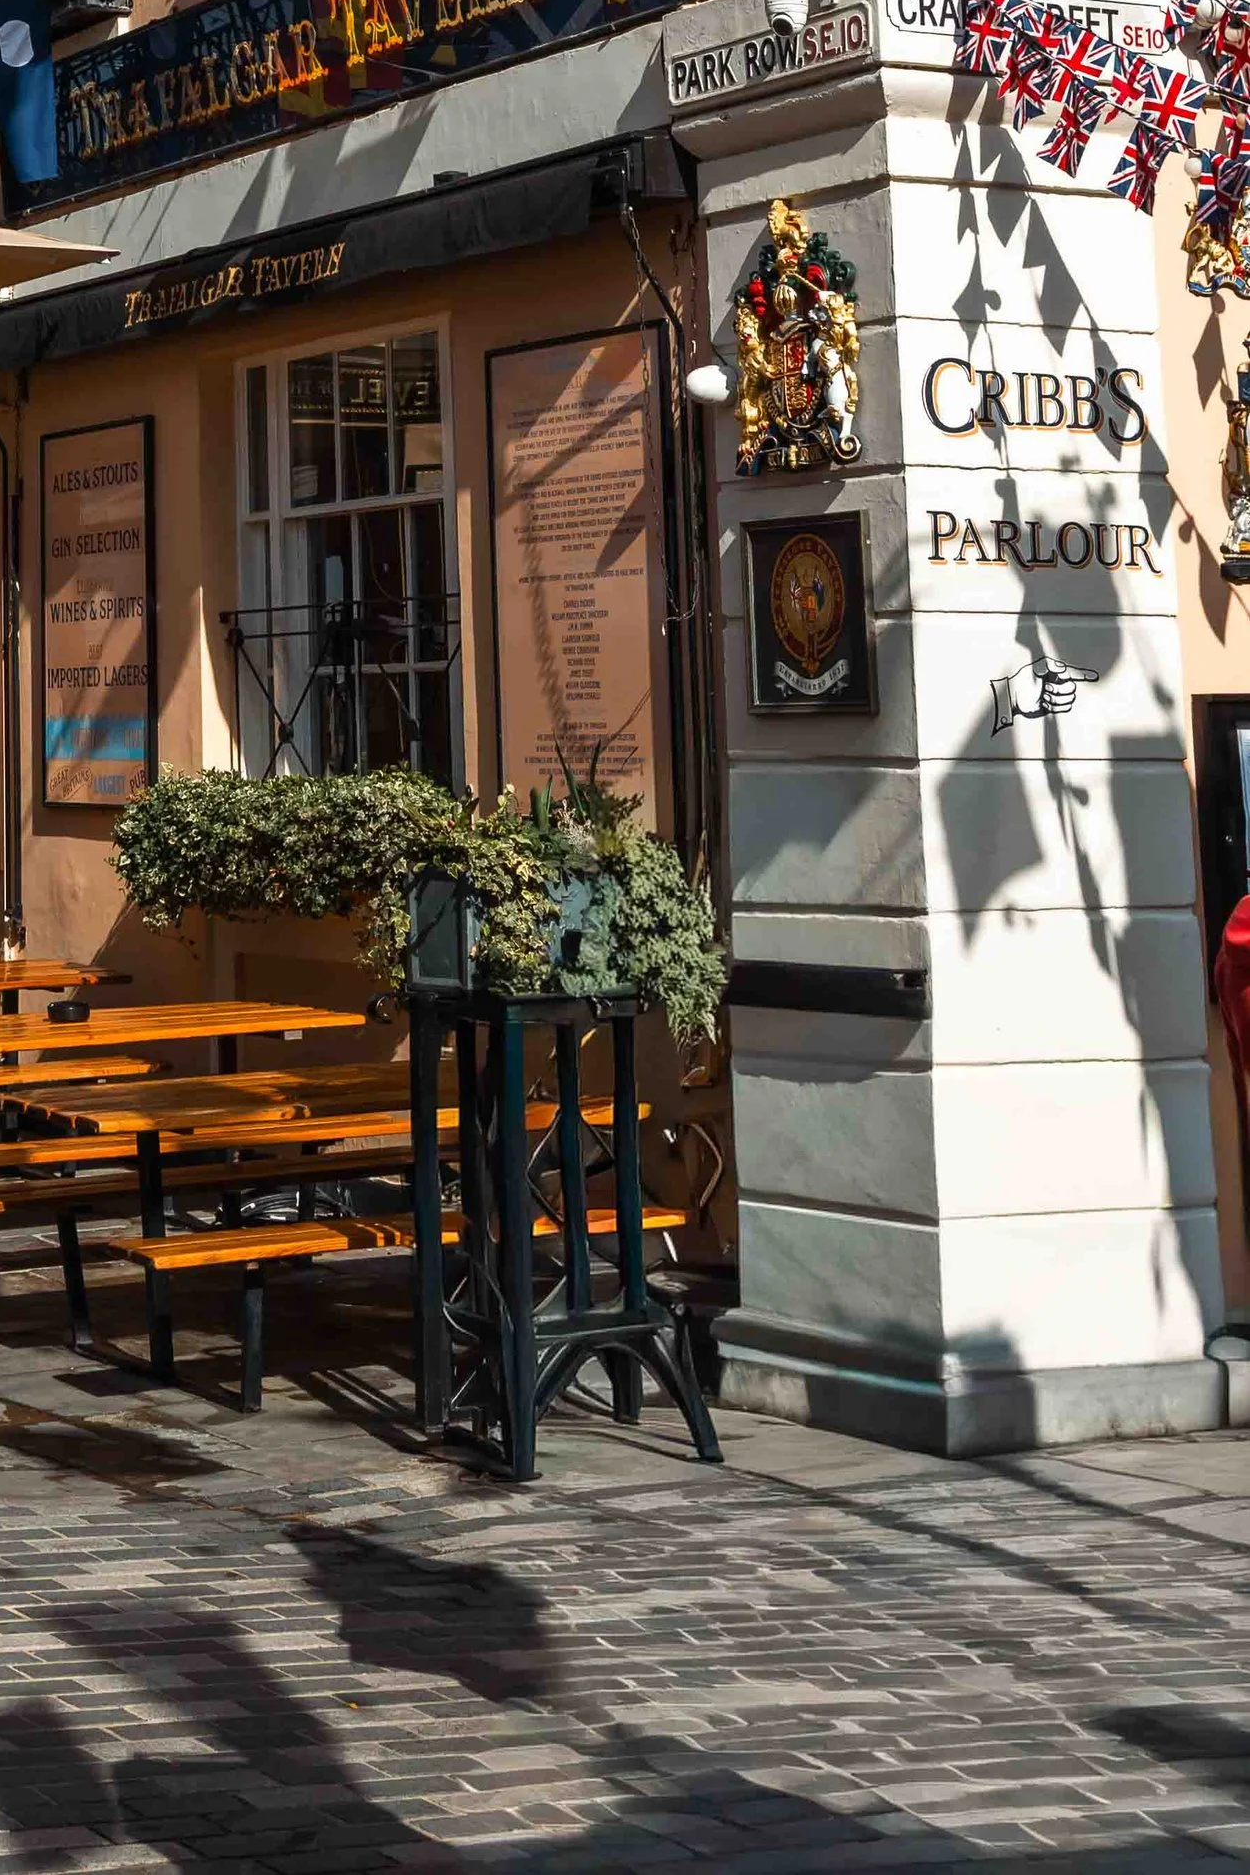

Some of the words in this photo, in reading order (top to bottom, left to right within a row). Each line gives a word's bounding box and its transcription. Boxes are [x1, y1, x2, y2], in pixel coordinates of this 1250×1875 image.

[1122, 24, 1164, 50] SE10
[68, 18, 330, 160] TRAFALGAR
[672, 47, 737, 100] PARK
[124, 265, 245, 329] TRAFALGAR
[251, 241, 347, 297] TAVERN
[922, 357, 1149, 446] CRIBB'S
[52, 470, 81, 494] ALES
[92, 461, 139, 489] STOUTS
[51, 537, 72, 559] GIN
[75, 527, 141, 556] SELECTION
[926, 510, 1162, 576] PARLOUR
[50, 598, 88, 623] WINES
[89, 599, 98, 621] &
[99, 595, 144, 620] SPIRITS
[47, 666, 101, 689] IMPORTED
[104, 664, 149, 687] LAGERS
